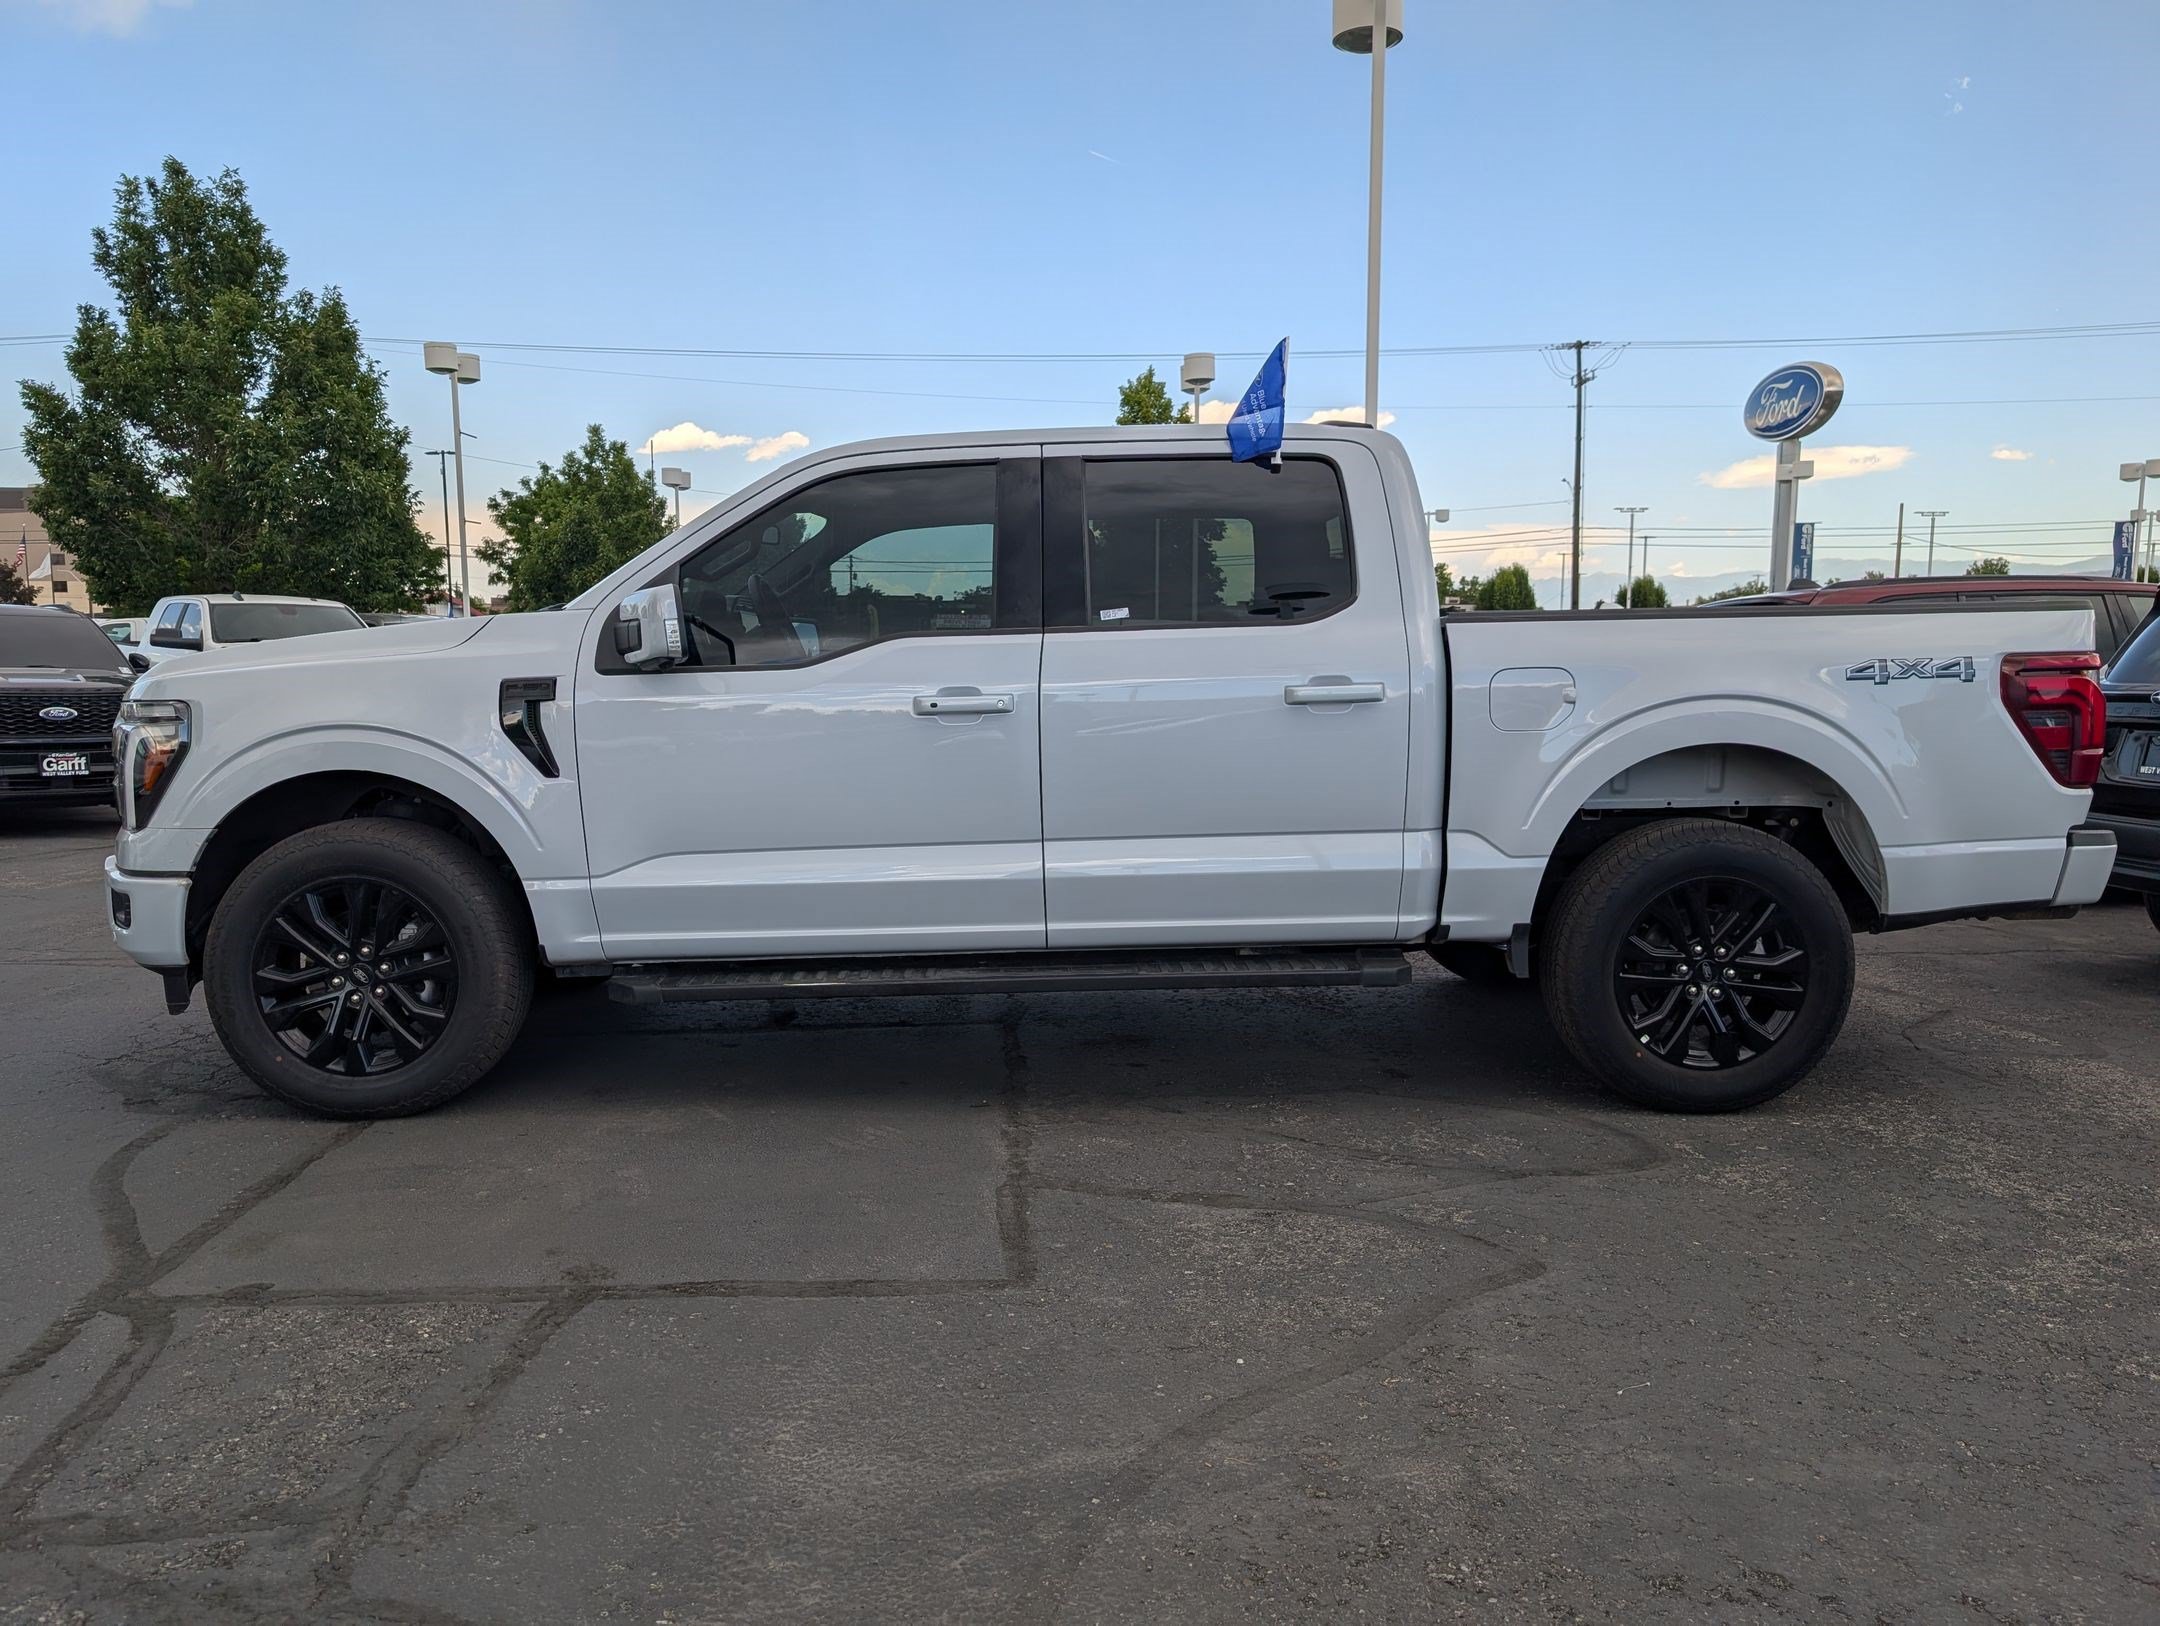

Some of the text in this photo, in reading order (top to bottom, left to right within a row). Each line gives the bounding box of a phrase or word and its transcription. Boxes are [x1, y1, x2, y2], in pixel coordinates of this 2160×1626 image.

[1257, 389, 1267, 410] Blue
[1756, 379, 1804, 427] Ford
[49, 709, 69, 717] Ford
[42, 756, 87, 771] Garff
[2140, 765, 2155, 774] WEST
